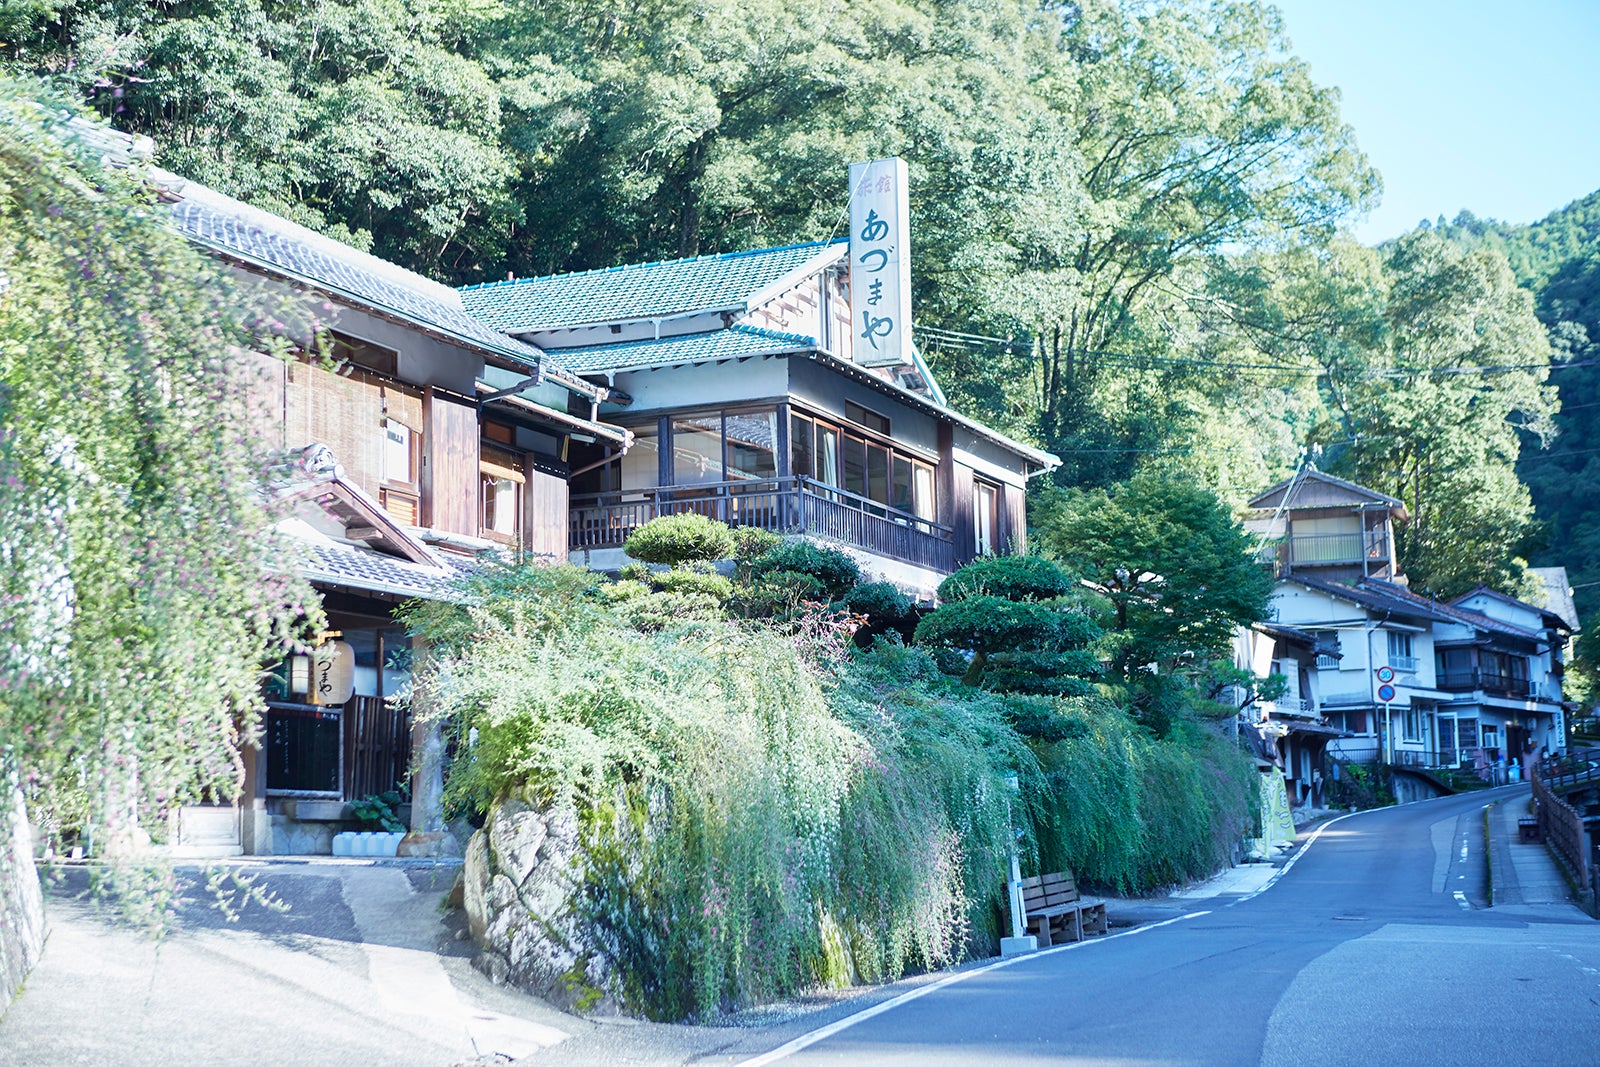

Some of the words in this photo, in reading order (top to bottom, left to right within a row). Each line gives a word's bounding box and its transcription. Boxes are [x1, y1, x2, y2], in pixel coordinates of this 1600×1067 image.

[860, 208, 894, 350] あづまや
[317, 656, 336, 696] づまや
[1380, 670, 1391, 679] 30
